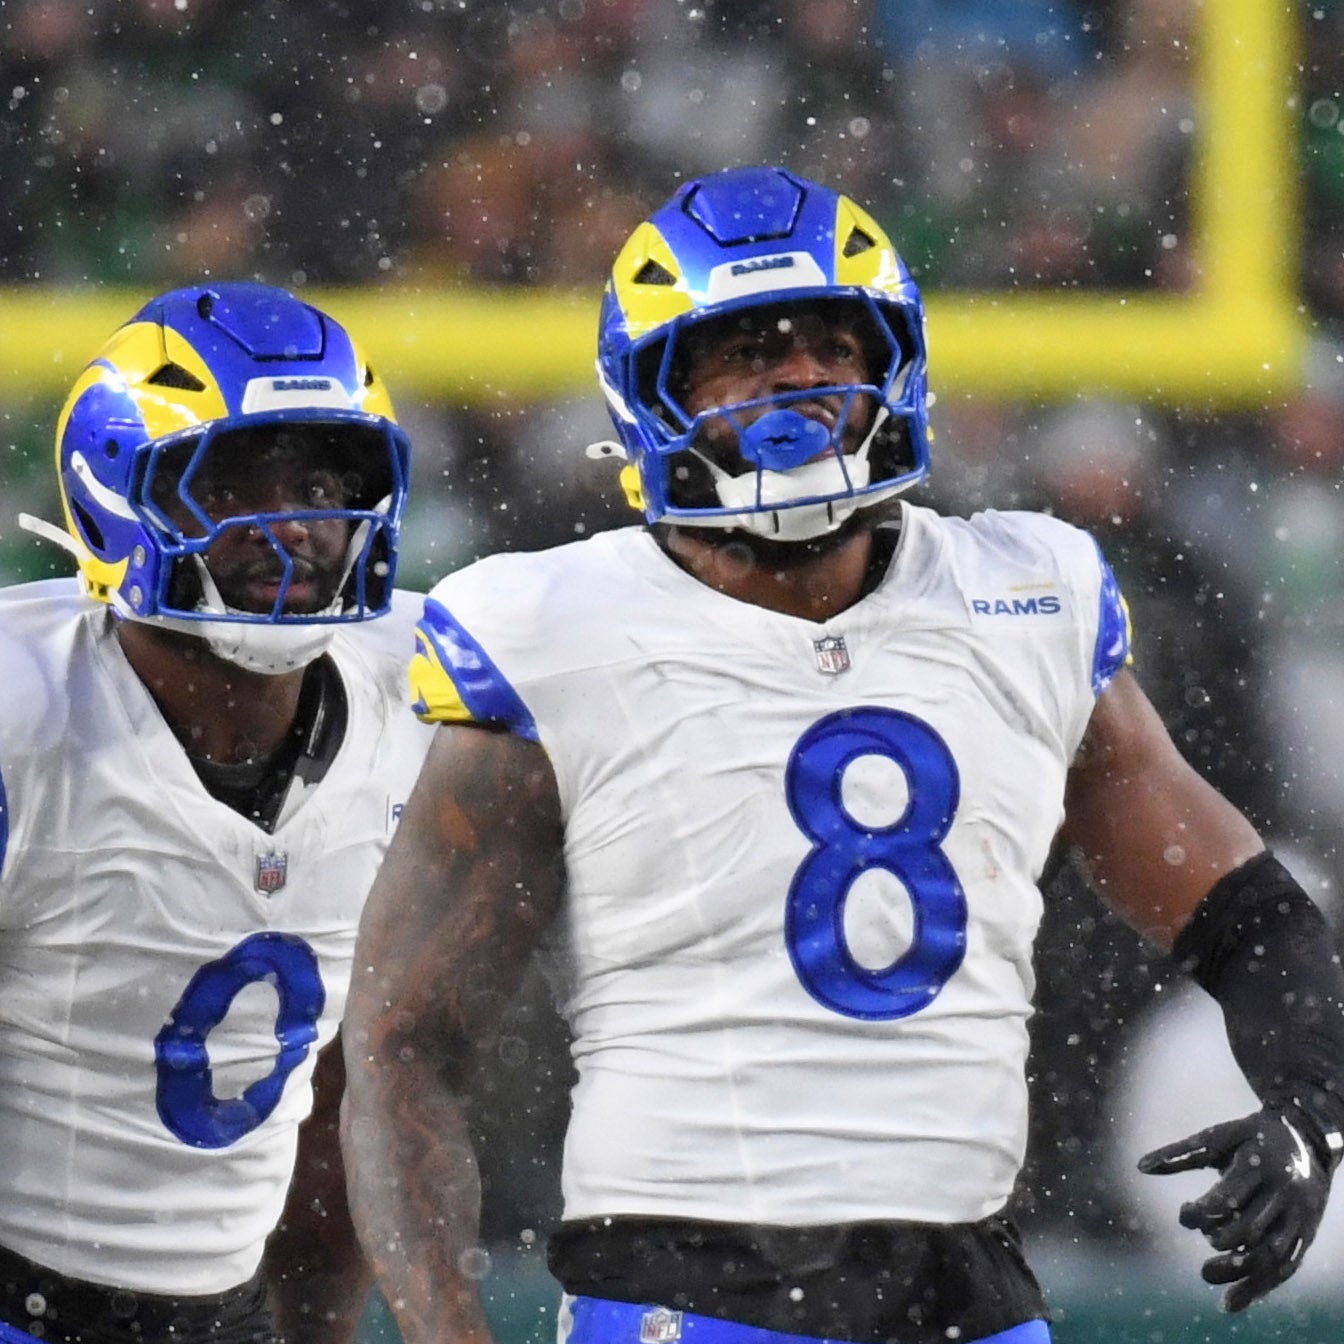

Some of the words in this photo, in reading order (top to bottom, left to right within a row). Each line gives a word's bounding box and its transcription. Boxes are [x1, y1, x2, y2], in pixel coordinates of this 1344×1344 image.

[972, 596, 1061, 615] RAMS
[784, 705, 968, 1021] 8
[154, 931, 326, 1149] 0
